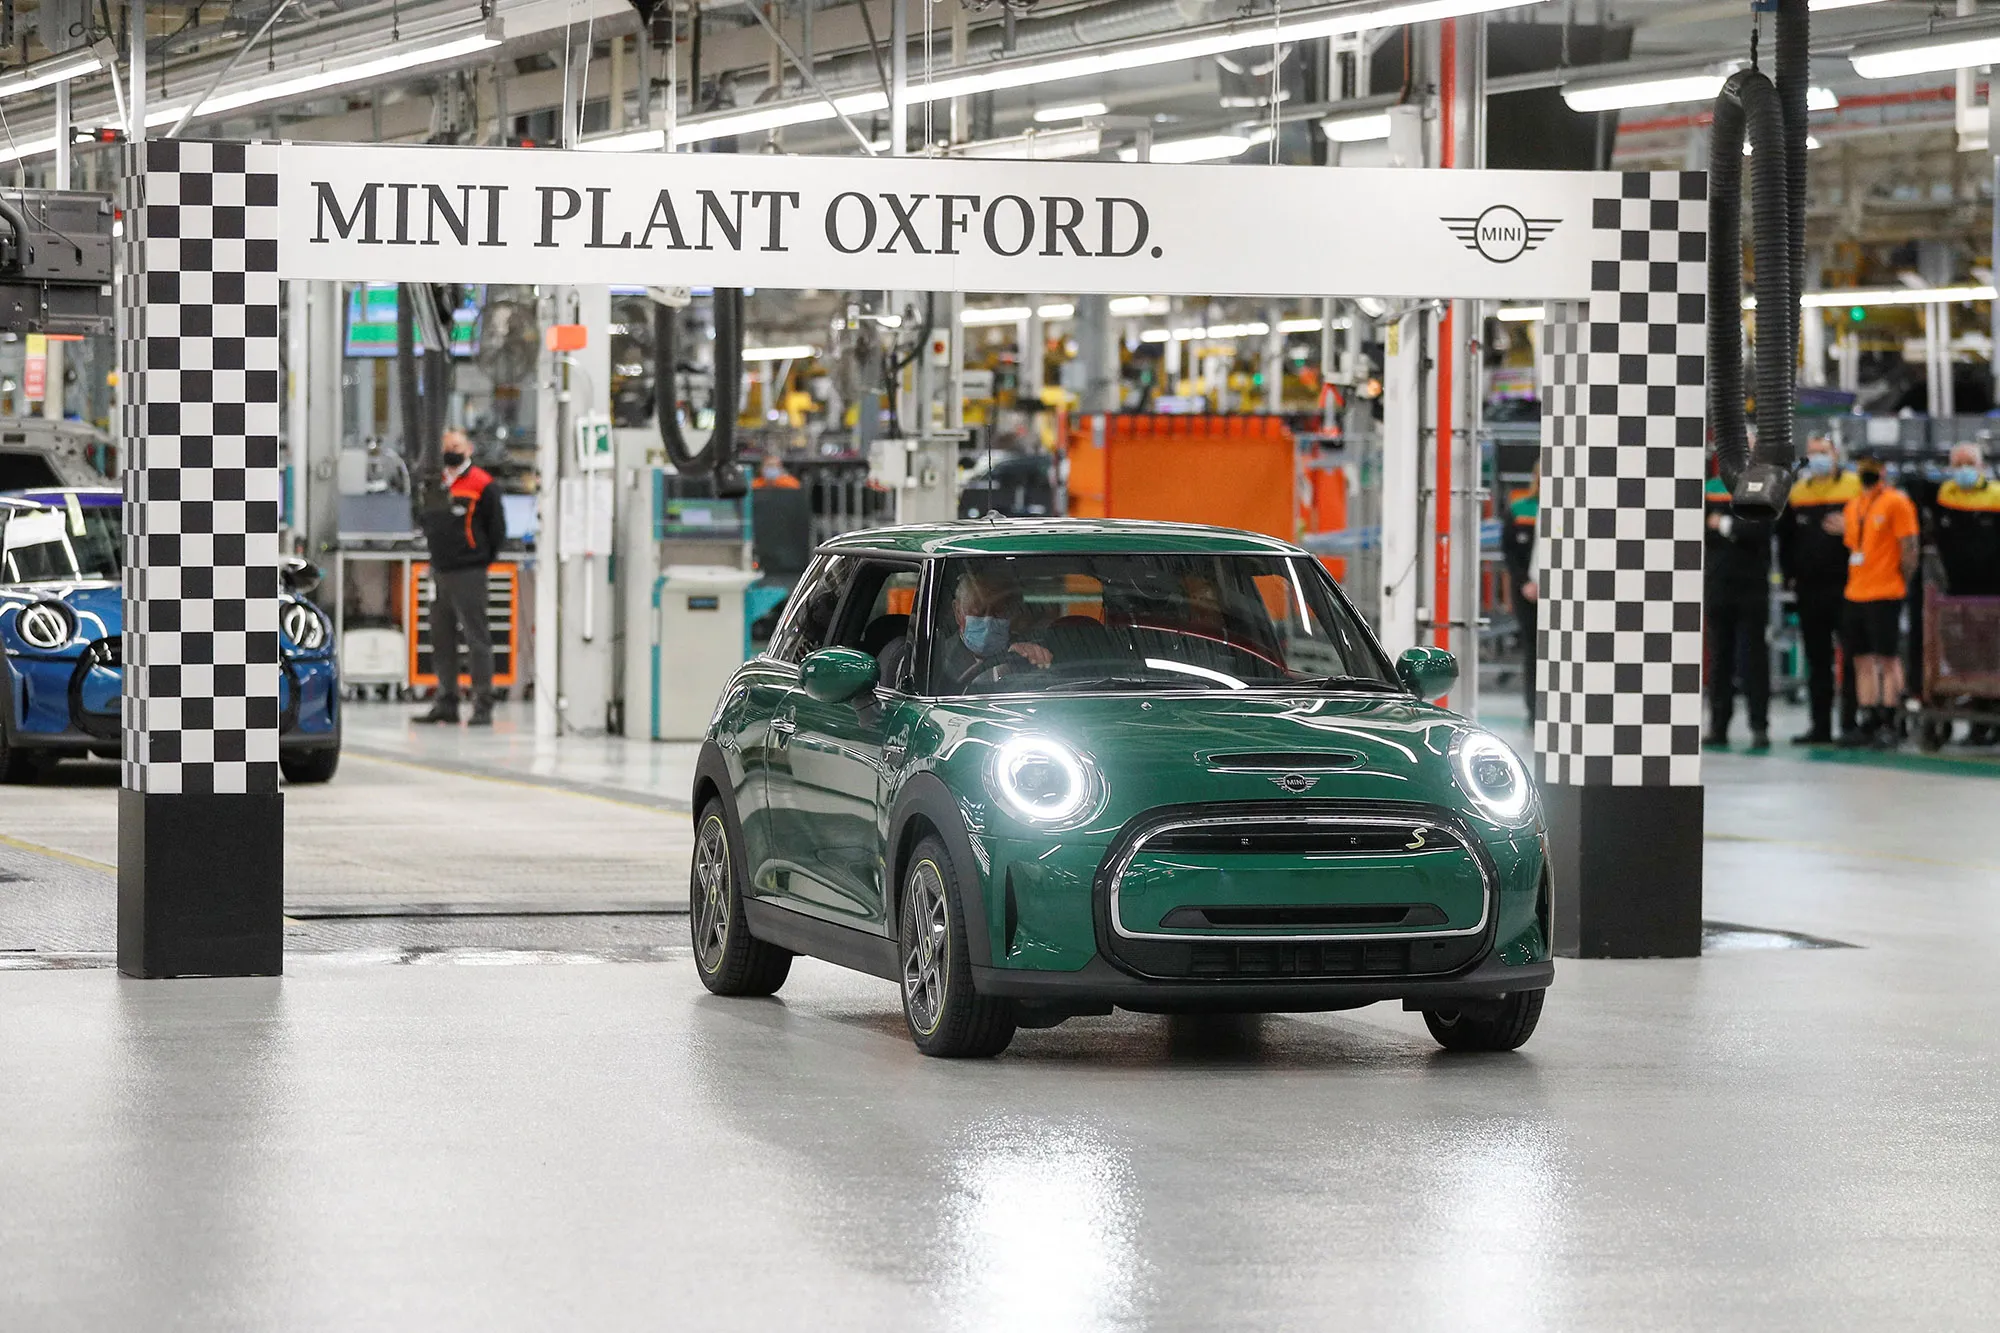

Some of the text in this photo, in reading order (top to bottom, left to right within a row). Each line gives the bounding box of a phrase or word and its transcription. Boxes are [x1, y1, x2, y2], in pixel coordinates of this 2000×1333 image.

[310, 182, 1163, 259] MINI PLANT OXFORD.
[1481, 226, 1521, 241] MINI
[1405, 827, 1428, 849] S
